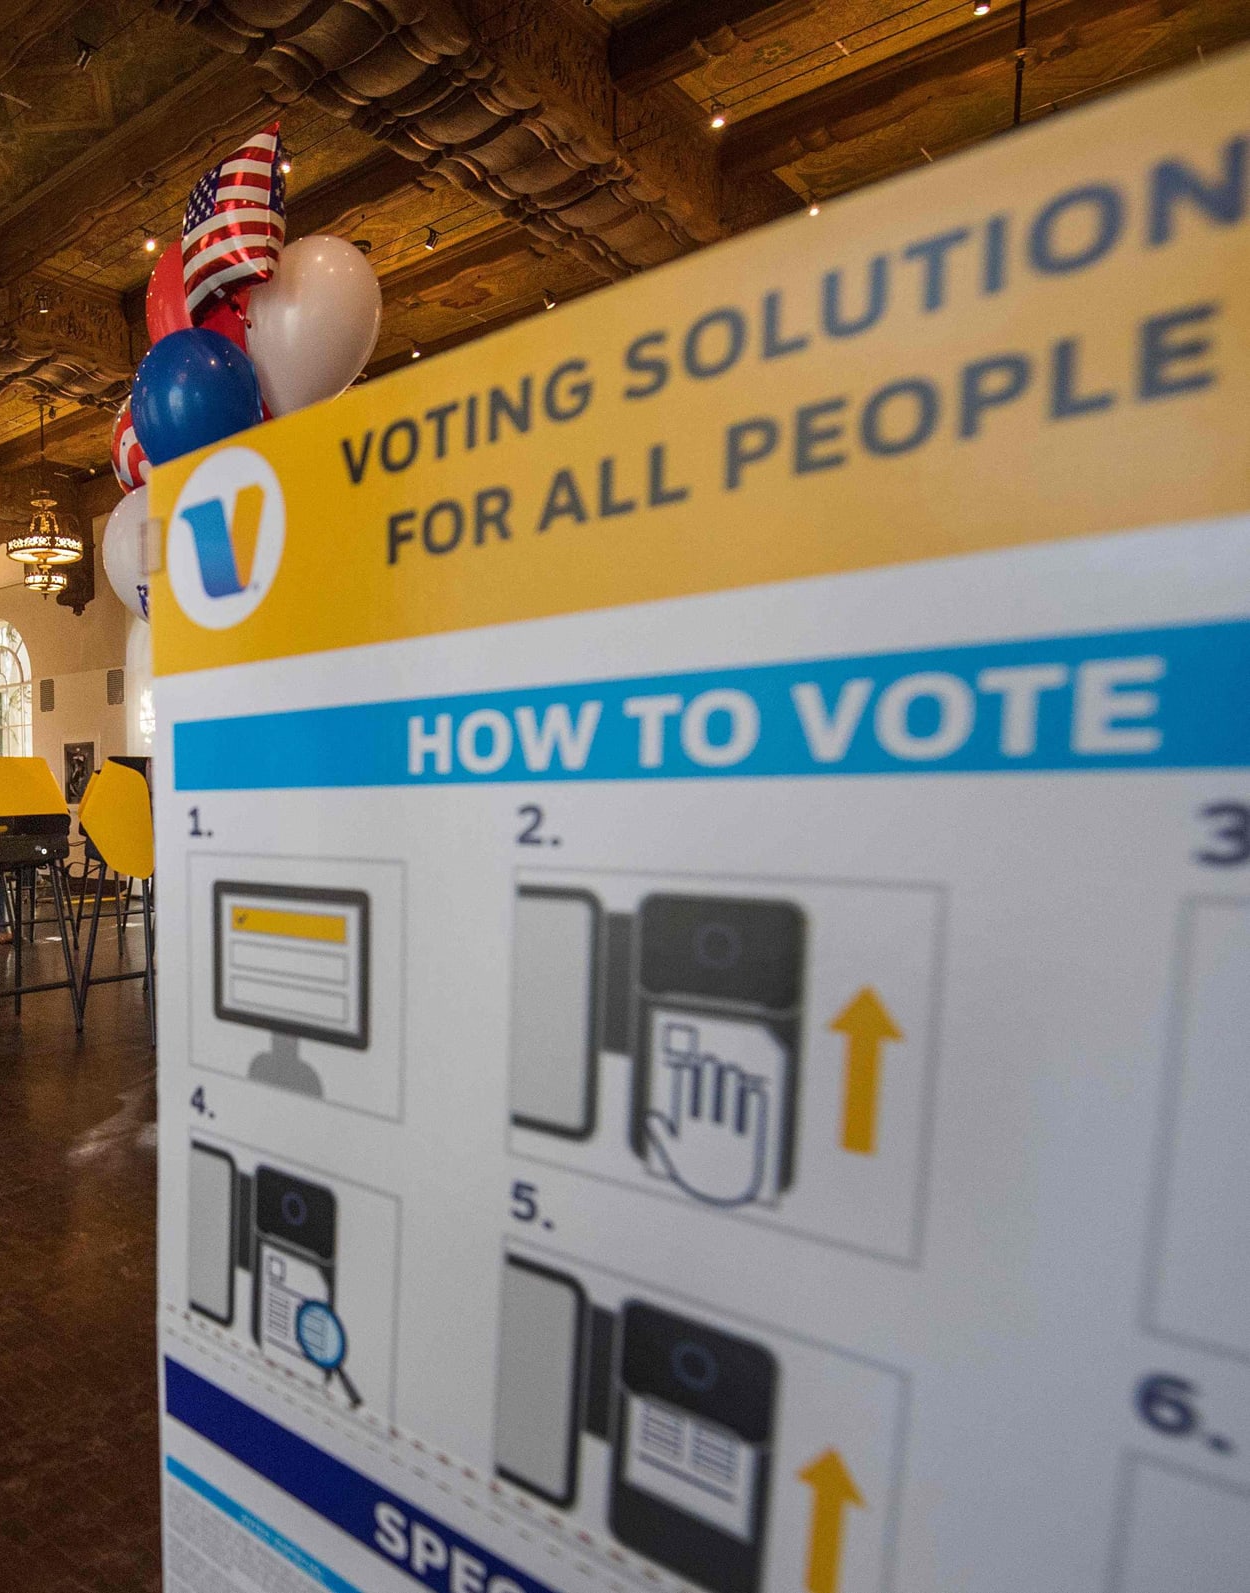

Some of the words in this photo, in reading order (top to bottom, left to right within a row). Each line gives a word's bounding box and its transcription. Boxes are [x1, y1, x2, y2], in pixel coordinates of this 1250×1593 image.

[340, 358, 594, 485] VOTING
[386, 485, 513, 566] FOR
[535, 443, 690, 536] ALL
[722, 303, 1222, 494] PEOPLE
[407, 700, 603, 776] HOW
[623, 687, 762, 769] TO
[790, 654, 1168, 764] VOTE
[187, 807, 214, 838] 1.
[515, 803, 563, 847] 2.
[190, 1086, 216, 1119] 4.
[510, 1180, 556, 1232] 5.
[1134, 1370, 1236, 1457] 6.
